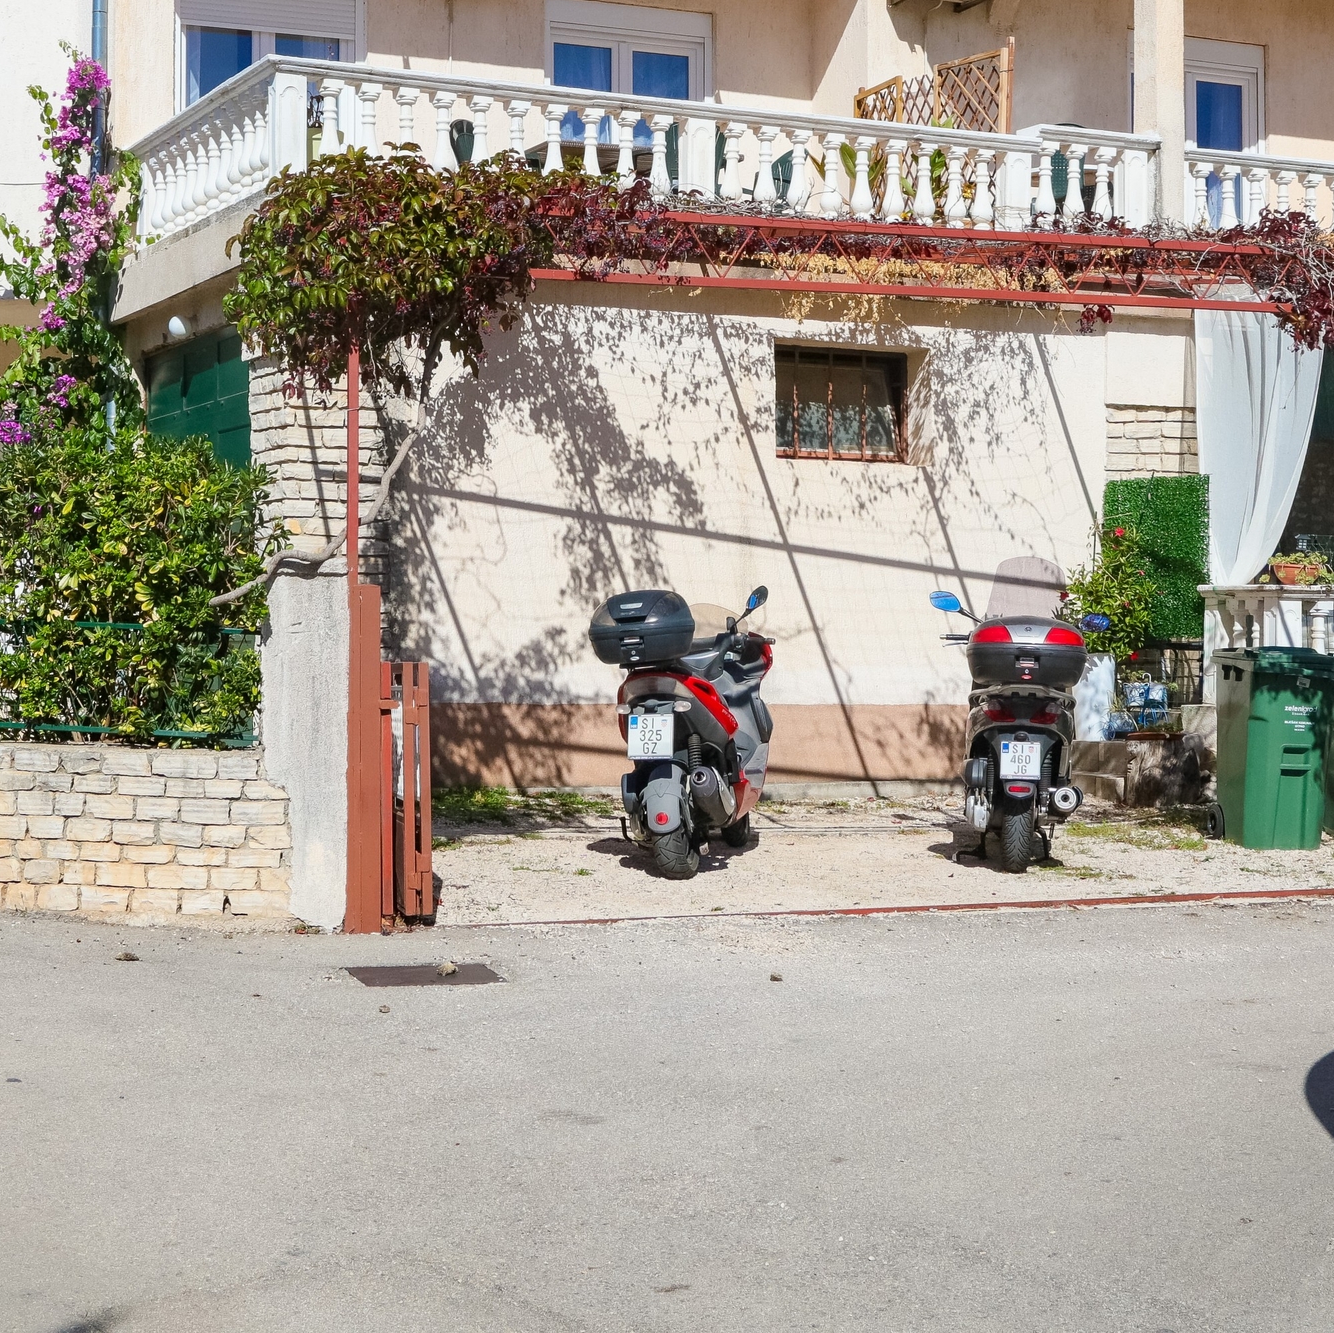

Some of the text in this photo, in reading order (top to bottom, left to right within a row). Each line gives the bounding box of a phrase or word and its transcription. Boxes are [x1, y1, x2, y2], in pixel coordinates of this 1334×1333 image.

[641, 718, 655, 729] SI
[639, 730, 663, 742] 325
[642, 742, 658, 754] GZ
[1012, 744, 1024, 754] SI
[1010, 754, 1031, 764] 460
[1013, 765, 1027, 775] JG
